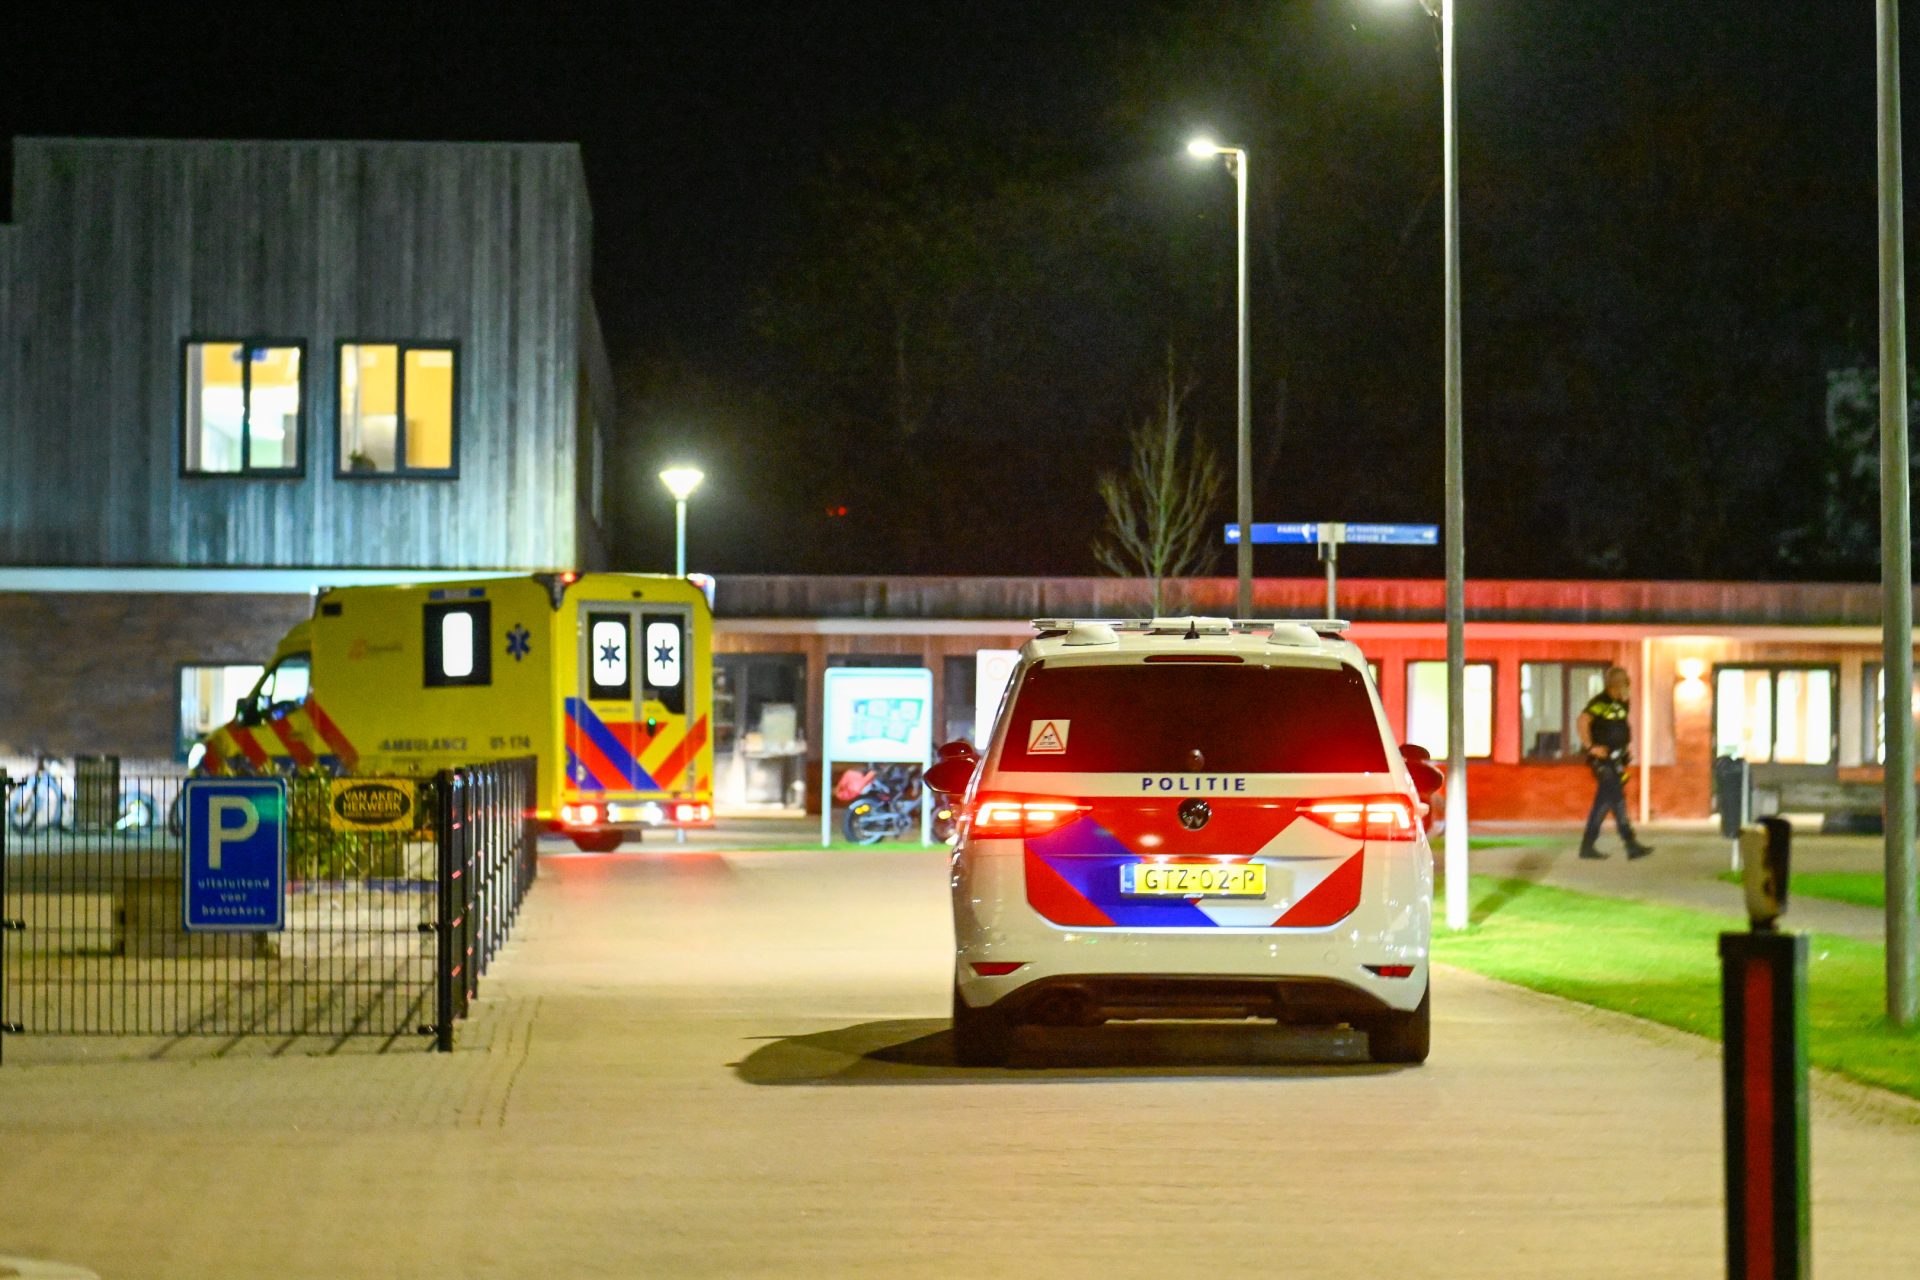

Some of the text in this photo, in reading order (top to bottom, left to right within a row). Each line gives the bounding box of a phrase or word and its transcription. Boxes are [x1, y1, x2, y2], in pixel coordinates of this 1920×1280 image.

[1142, 777, 1246, 791] POLITIE
[344, 791, 402, 801] VAN AKEN
[208, 794, 260, 870] P
[199, 877, 270, 889] uitsluitend
[1145, 869, 1255, 890] GTZ-02-P
[220, 893, 247, 903] voor
